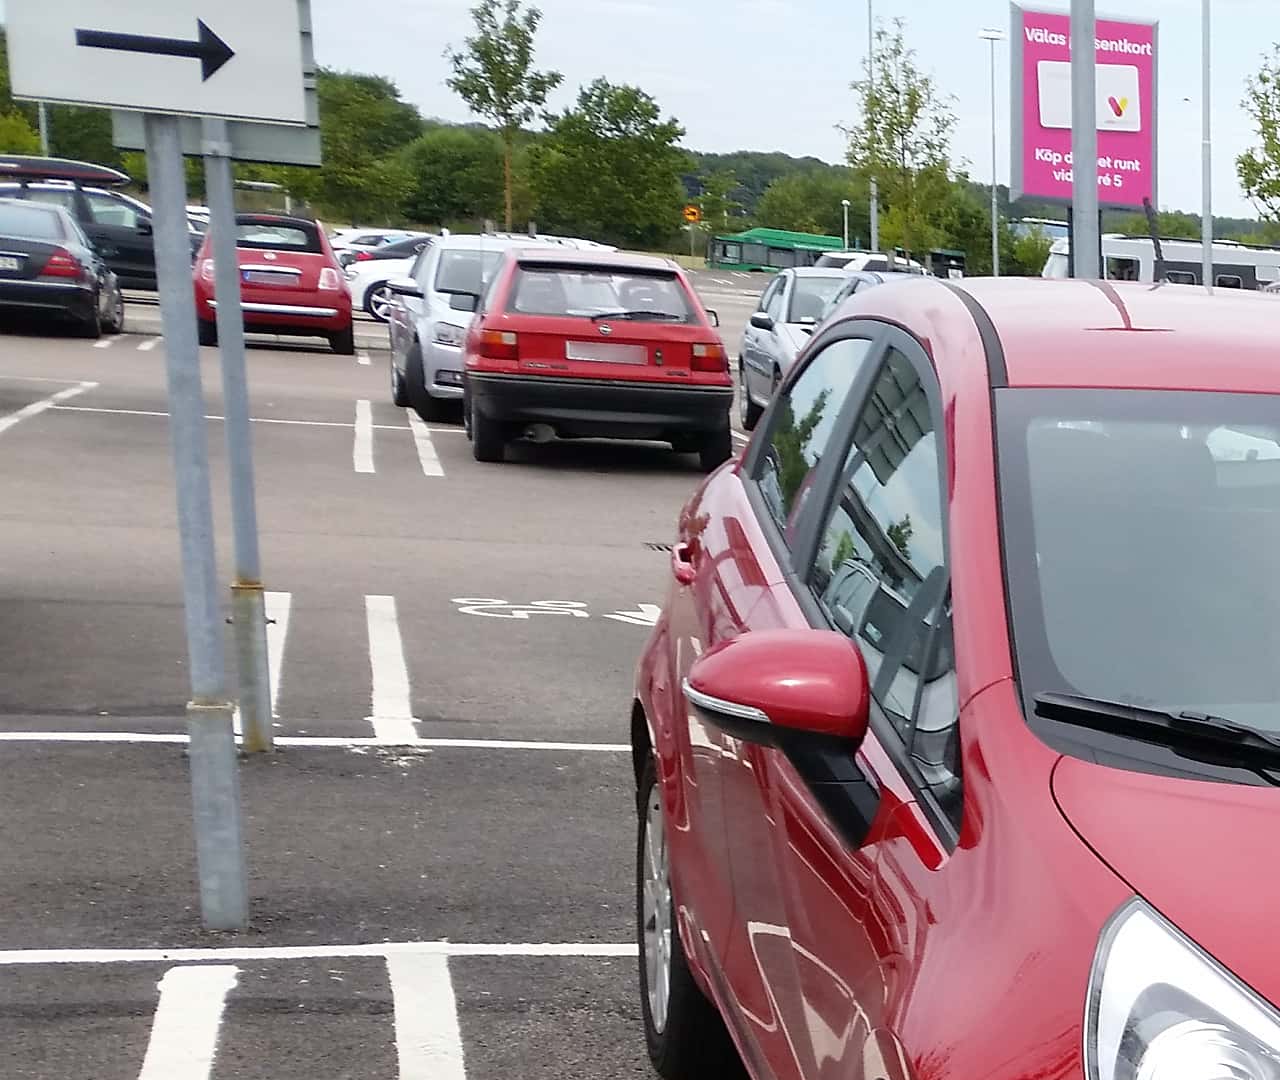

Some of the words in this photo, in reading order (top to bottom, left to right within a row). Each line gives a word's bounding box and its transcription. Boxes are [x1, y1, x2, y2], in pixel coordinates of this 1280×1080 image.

[1024, 26, 1066, 46] Välas
[1068, 36, 1153, 56] sentkort
[1035, 147, 1063, 166] Köp
[1113, 158, 1141, 172] runt
[1113, 173, 1123, 188] 5
